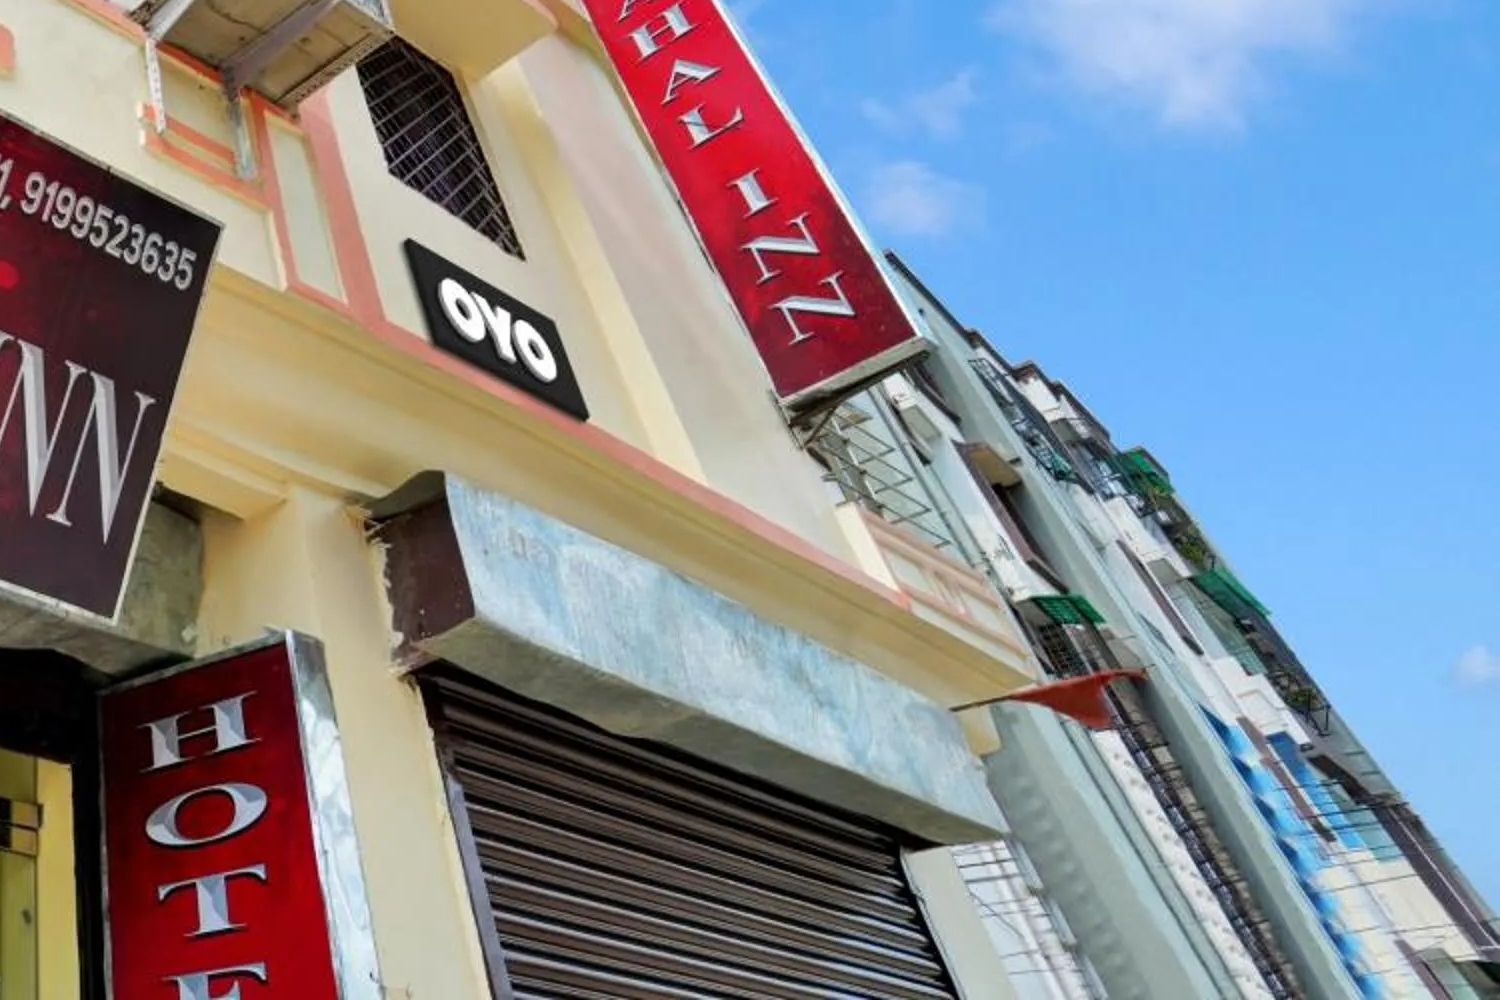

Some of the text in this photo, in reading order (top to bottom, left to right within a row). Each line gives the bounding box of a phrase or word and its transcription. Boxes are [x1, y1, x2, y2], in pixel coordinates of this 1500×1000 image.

[19, 171, 197, 291] 9199523635
[726, 169, 855, 346] INN
[437, 277, 558, 383] OYO
